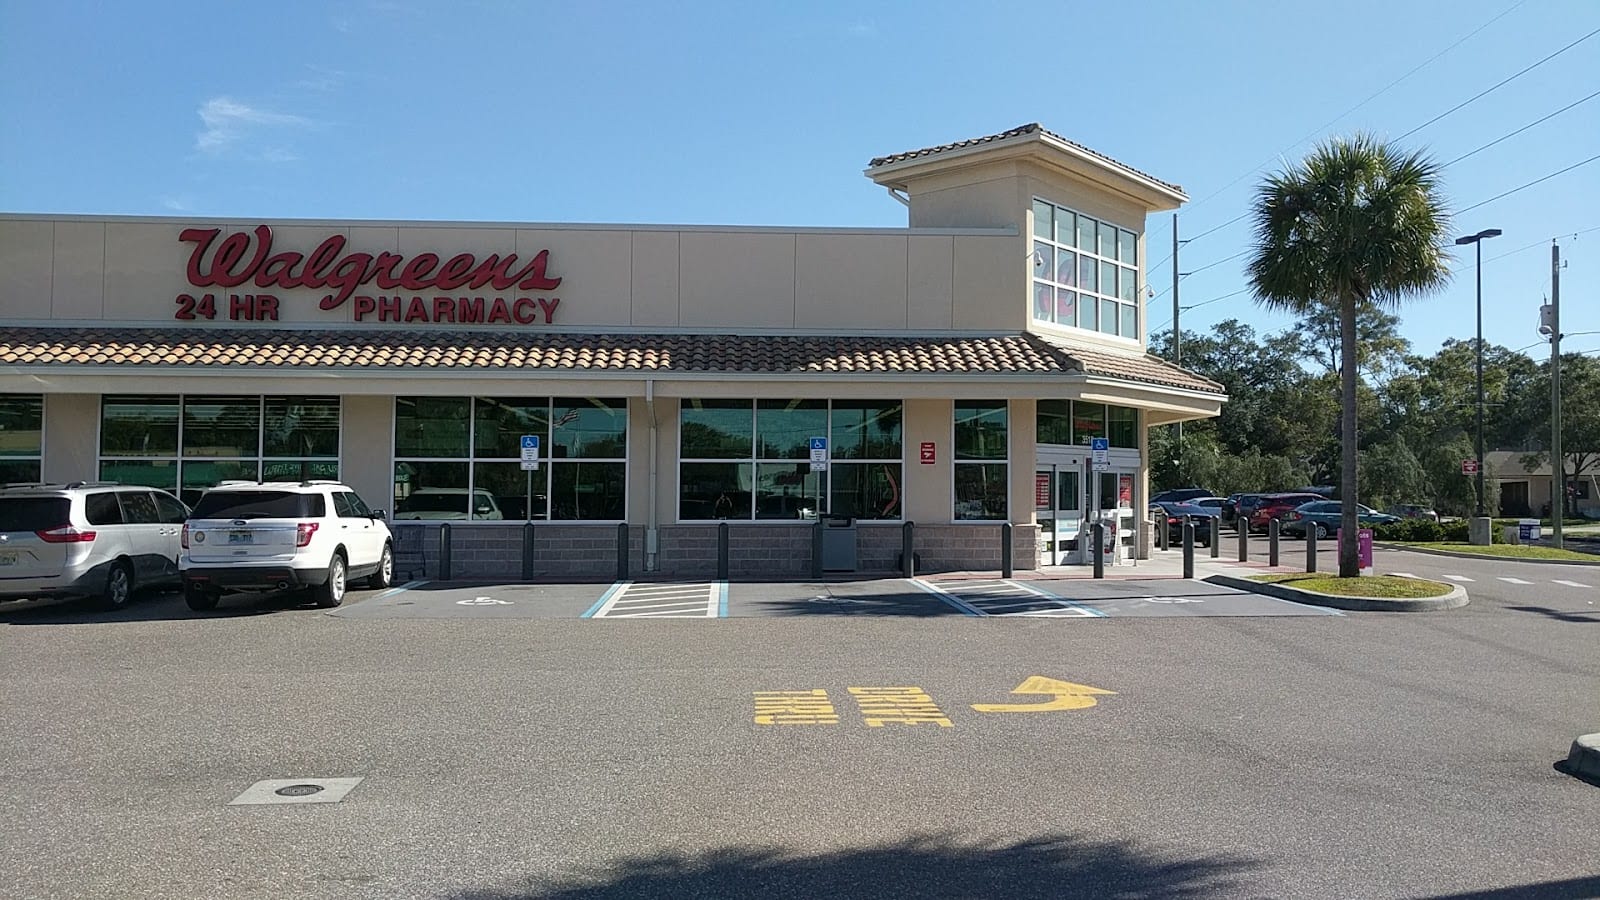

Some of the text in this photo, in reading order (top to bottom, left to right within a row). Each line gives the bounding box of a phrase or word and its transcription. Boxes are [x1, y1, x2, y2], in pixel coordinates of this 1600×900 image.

[179, 225, 562, 310] Walgreens
[175, 294, 561, 324] 24 HR PHARMACY
[752, 688, 839, 724] THRU
[847, 686, 954, 727] DRIVE
